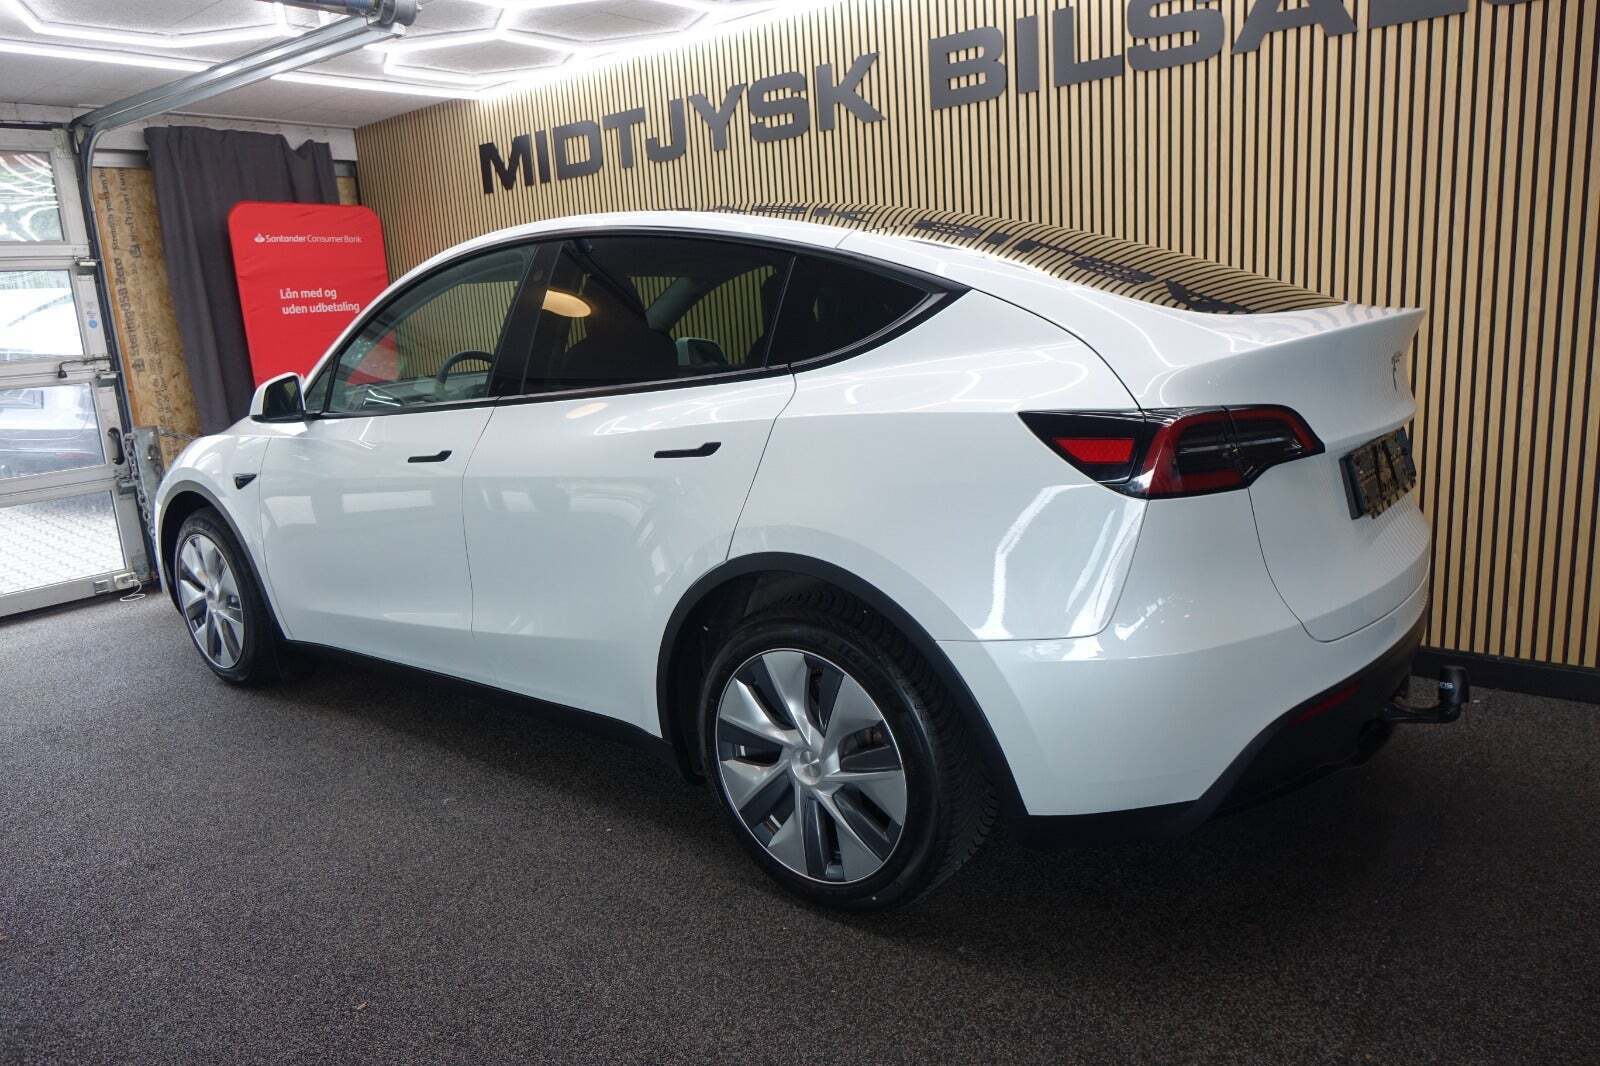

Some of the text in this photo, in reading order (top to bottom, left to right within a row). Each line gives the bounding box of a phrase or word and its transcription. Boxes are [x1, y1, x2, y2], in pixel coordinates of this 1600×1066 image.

[478, 0, 1550, 194] MIDTJYSK BILSA
[265, 234, 305, 243] Santander
[280, 288, 337, 299] Lån med og
[282, 301, 360, 315] uden udbetaling
